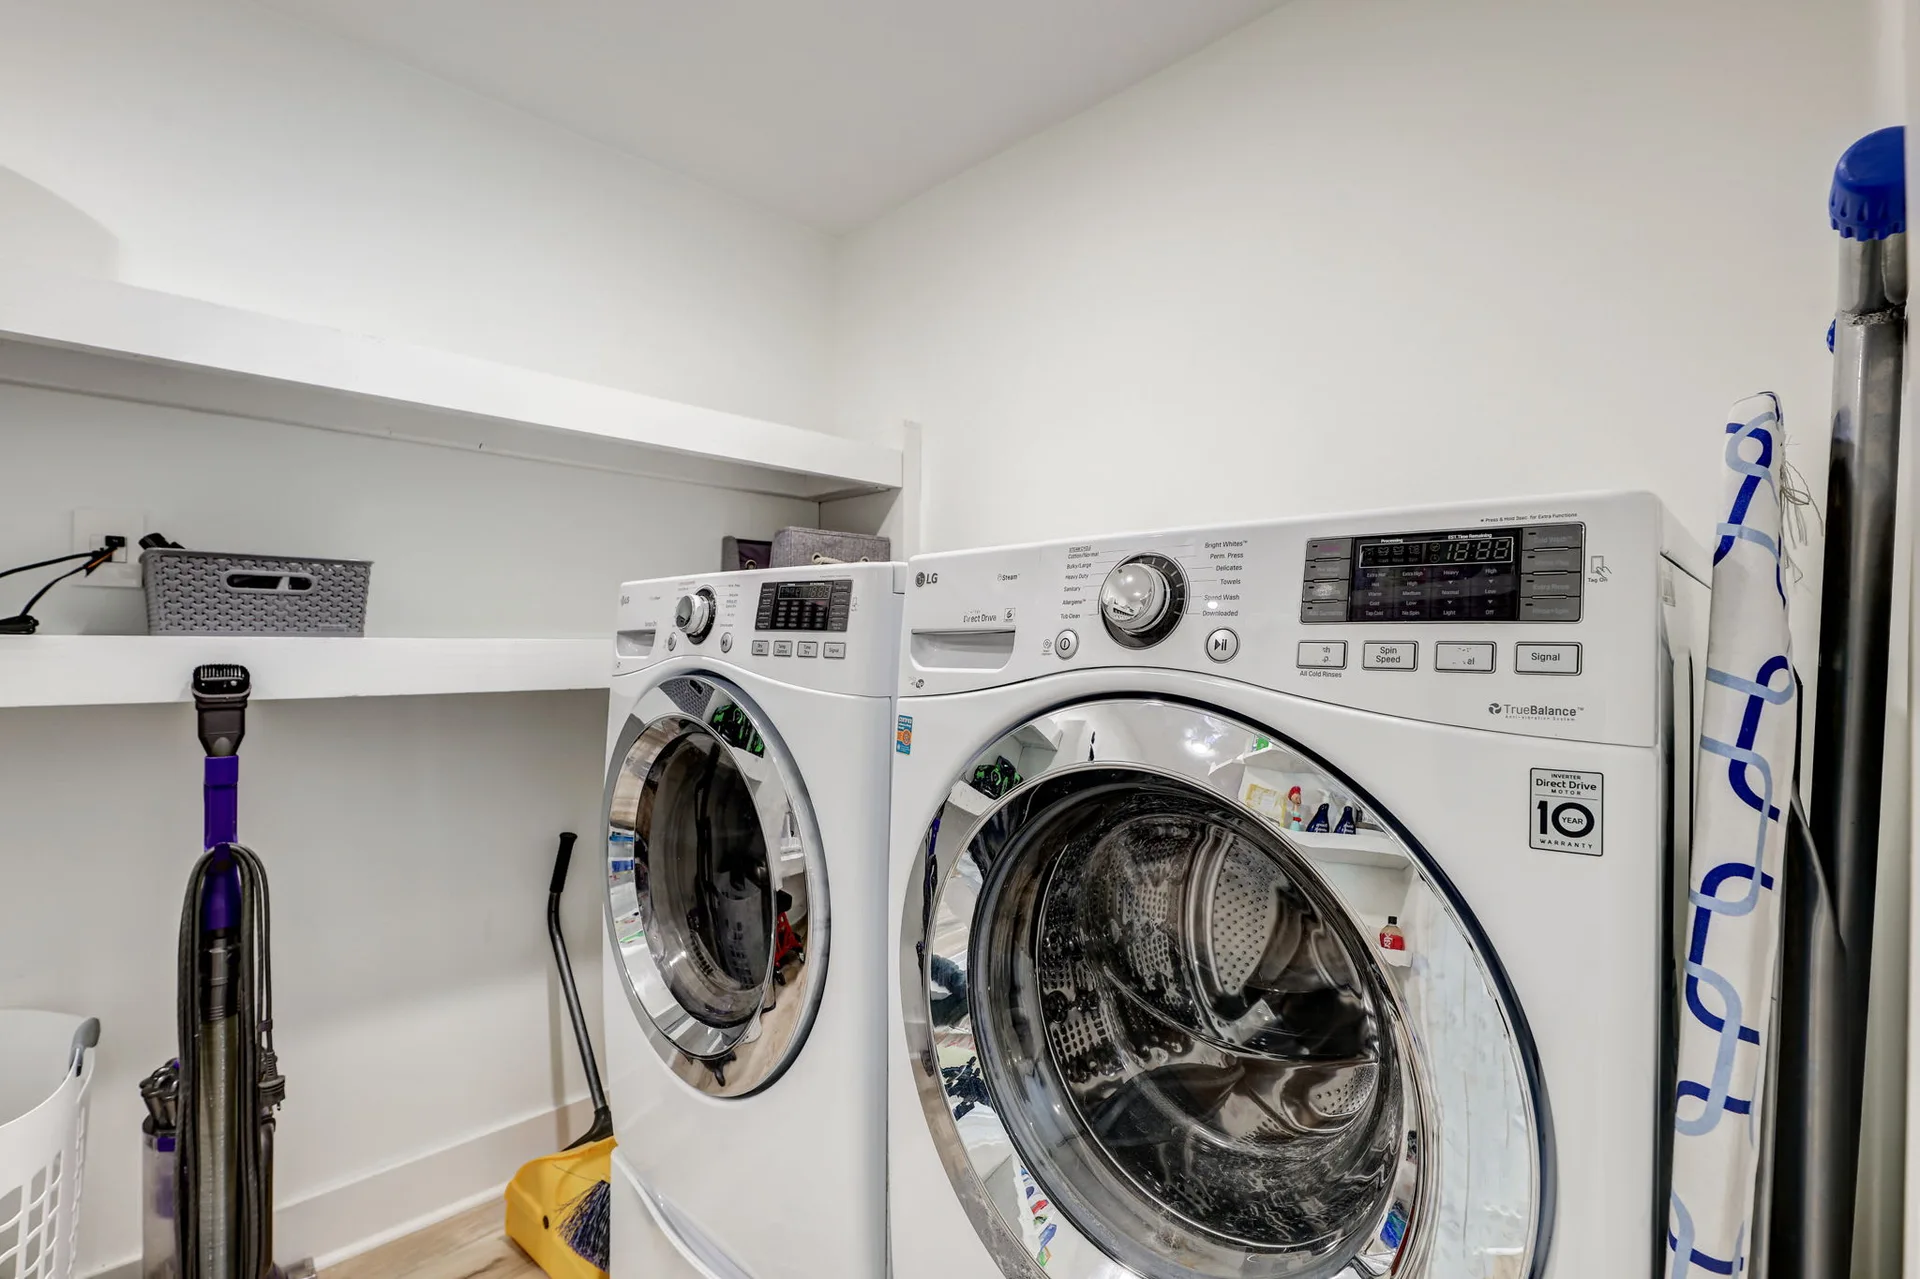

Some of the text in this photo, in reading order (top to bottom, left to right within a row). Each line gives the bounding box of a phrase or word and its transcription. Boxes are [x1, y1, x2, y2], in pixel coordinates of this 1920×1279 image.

[926, 573, 938, 584] LG
[1379, 646, 1398, 655] Spin
[1375, 655, 1401, 664] Speed
[1531, 652, 1560, 662] Signal
[1536, 778, 1597, 790] Direct Drive
[1537, 800, 1595, 838] 10
[1561, 816, 1584, 825] YEAR
[1539, 838, 1593, 849] WARRANTY
